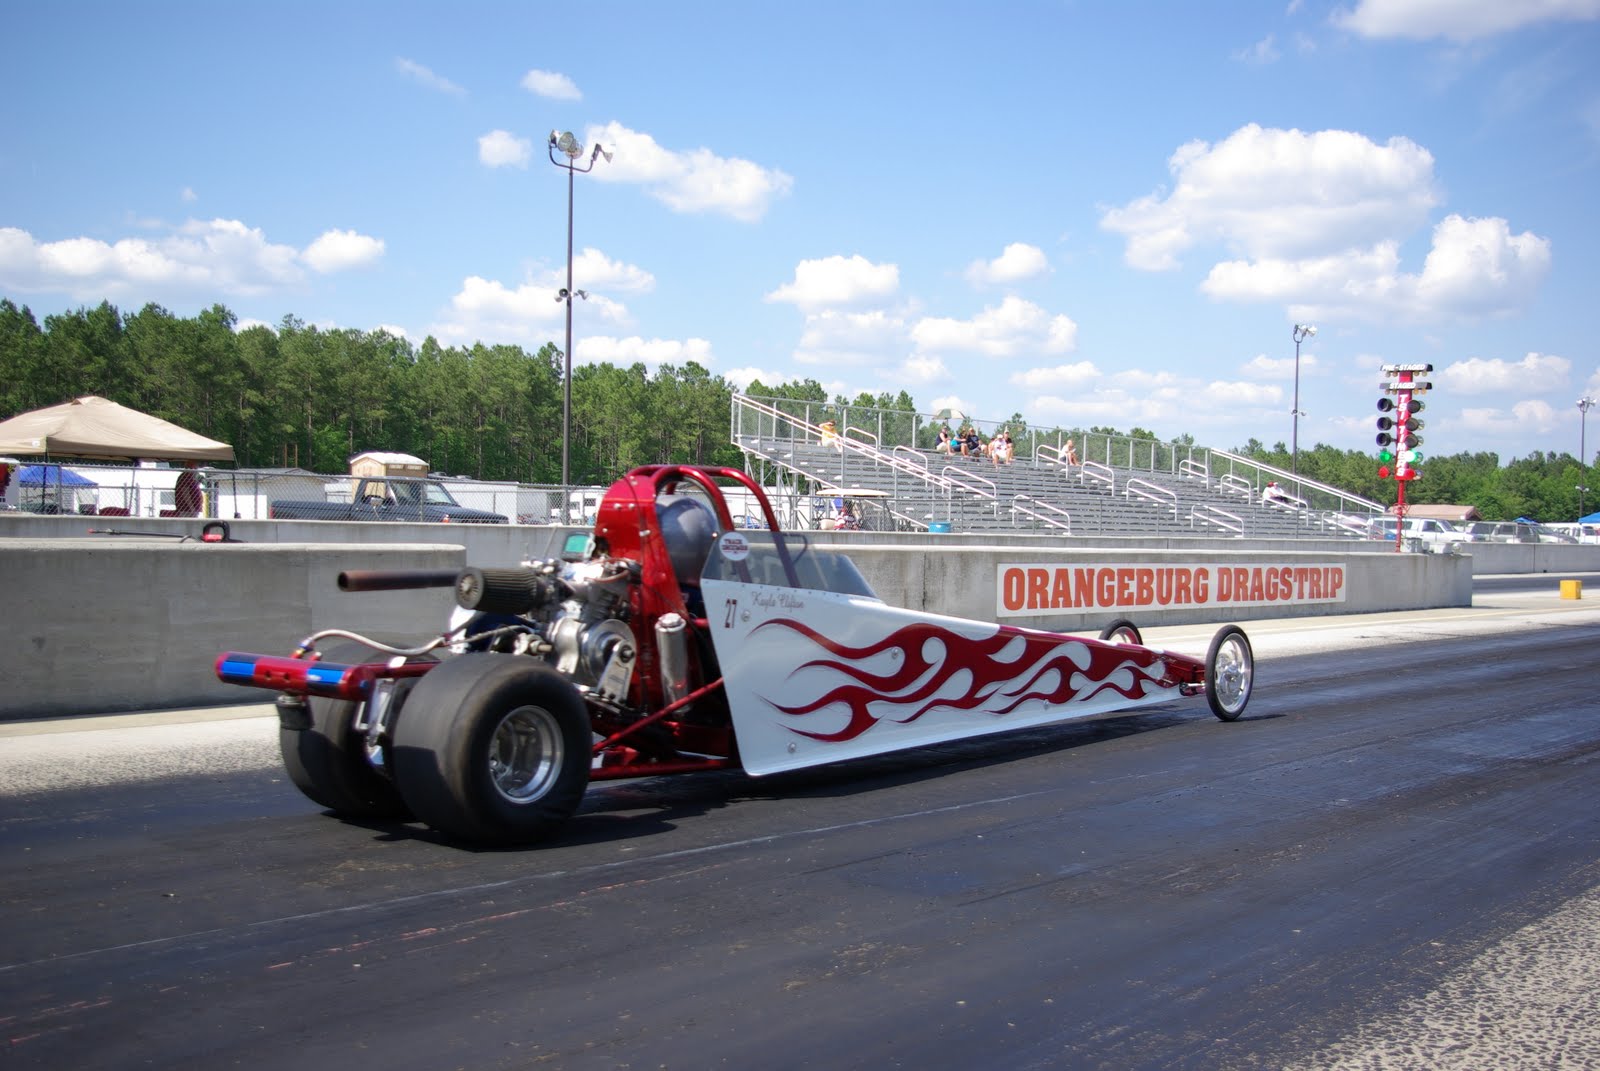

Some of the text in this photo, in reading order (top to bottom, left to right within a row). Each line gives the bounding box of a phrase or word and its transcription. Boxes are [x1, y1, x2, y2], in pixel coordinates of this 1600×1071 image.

[1396, 394, 1408, 477] TSI TIMERS
[1003, 566, 1343, 611] ORANGEBURG DRAGSTRIP
[725, 598, 737, 628] 27
